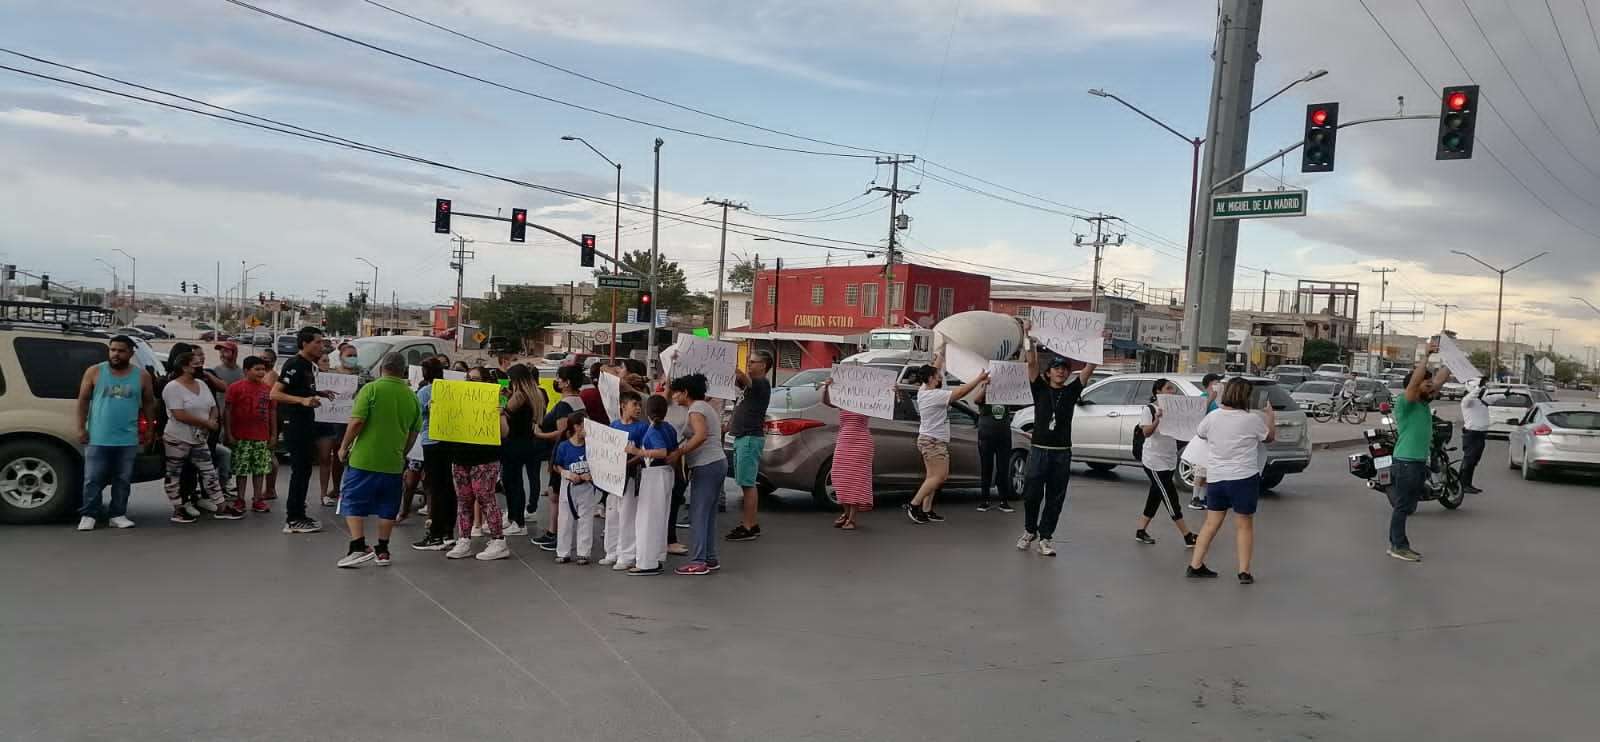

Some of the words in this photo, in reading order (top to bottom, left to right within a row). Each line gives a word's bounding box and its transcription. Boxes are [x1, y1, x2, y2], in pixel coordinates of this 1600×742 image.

[1228, 200, 1250, 212] MIGUEL
[1252, 200, 1262, 211] DE
[1263, 199, 1272, 210] LA
[1274, 198, 1299, 209] MADRID
[794, 314, 825, 328] CARNITAS
[828, 315, 854, 328] ESTILO
[1031, 308, 1049, 329] ME
[1054, 311, 1102, 332] QUIERO
